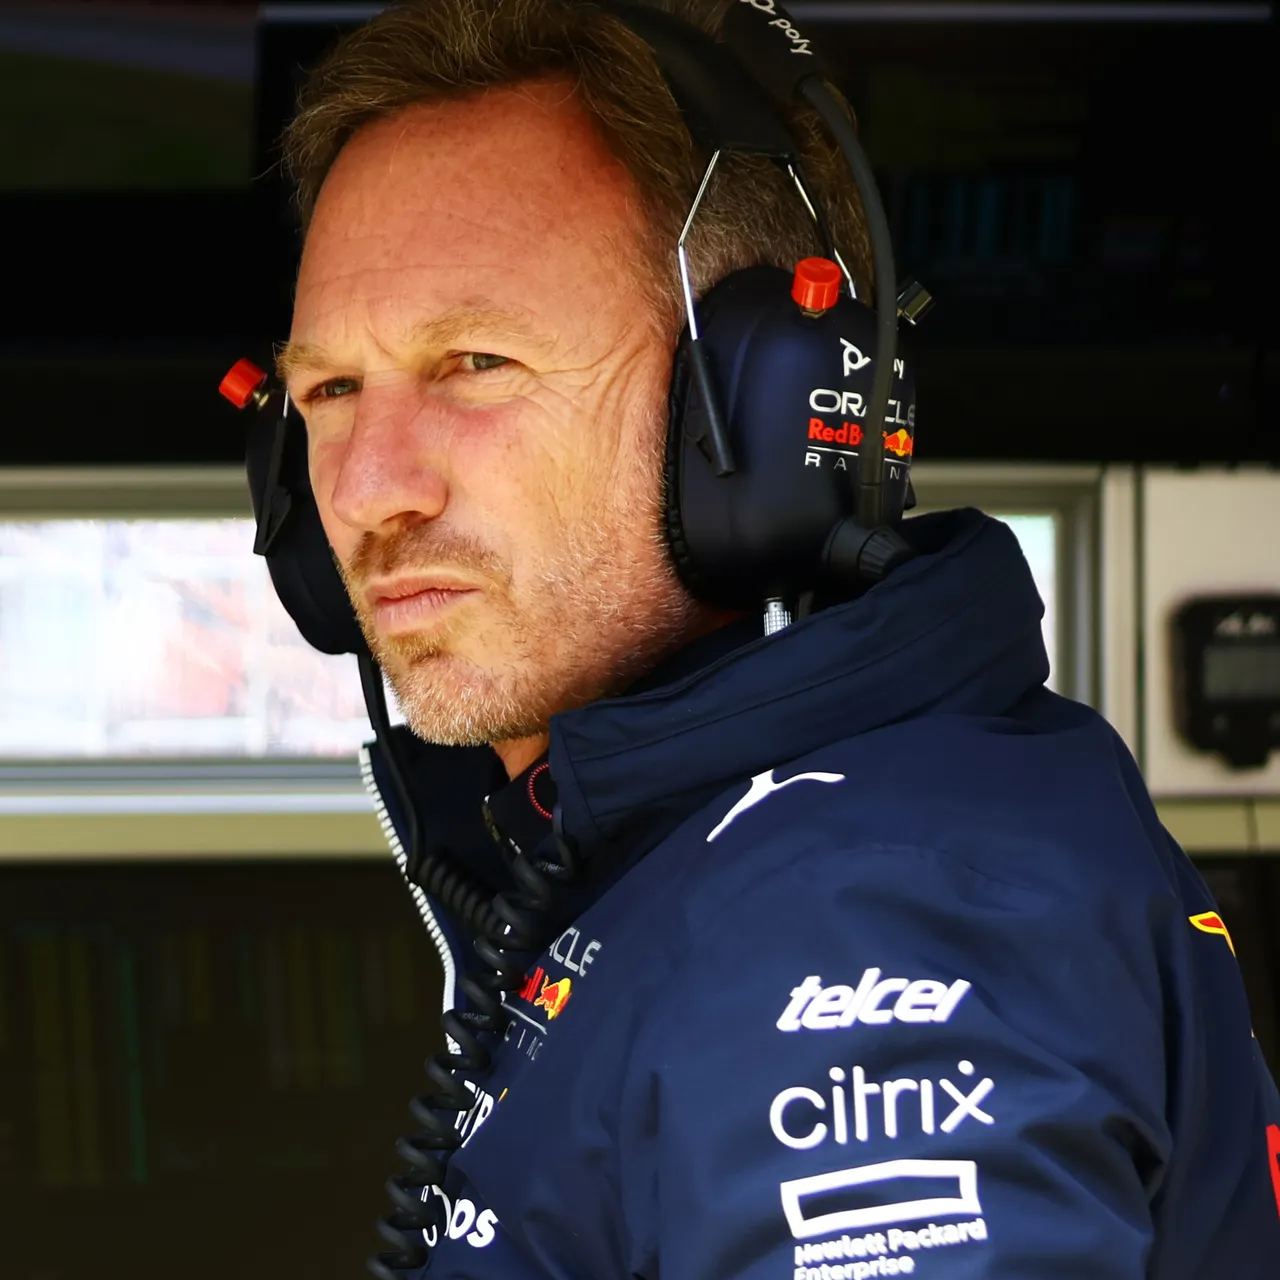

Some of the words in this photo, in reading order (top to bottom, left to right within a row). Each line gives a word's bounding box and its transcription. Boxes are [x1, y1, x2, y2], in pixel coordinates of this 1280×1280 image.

[768, 18, 813, 55] poly
[808, 417, 864, 446] RedB
[776, 967, 972, 1032] telcel
[769, 1060, 996, 1149] citrix
[794, 1232, 888, 1267] Hewlett
[887, 1217, 987, 1252] Packard
